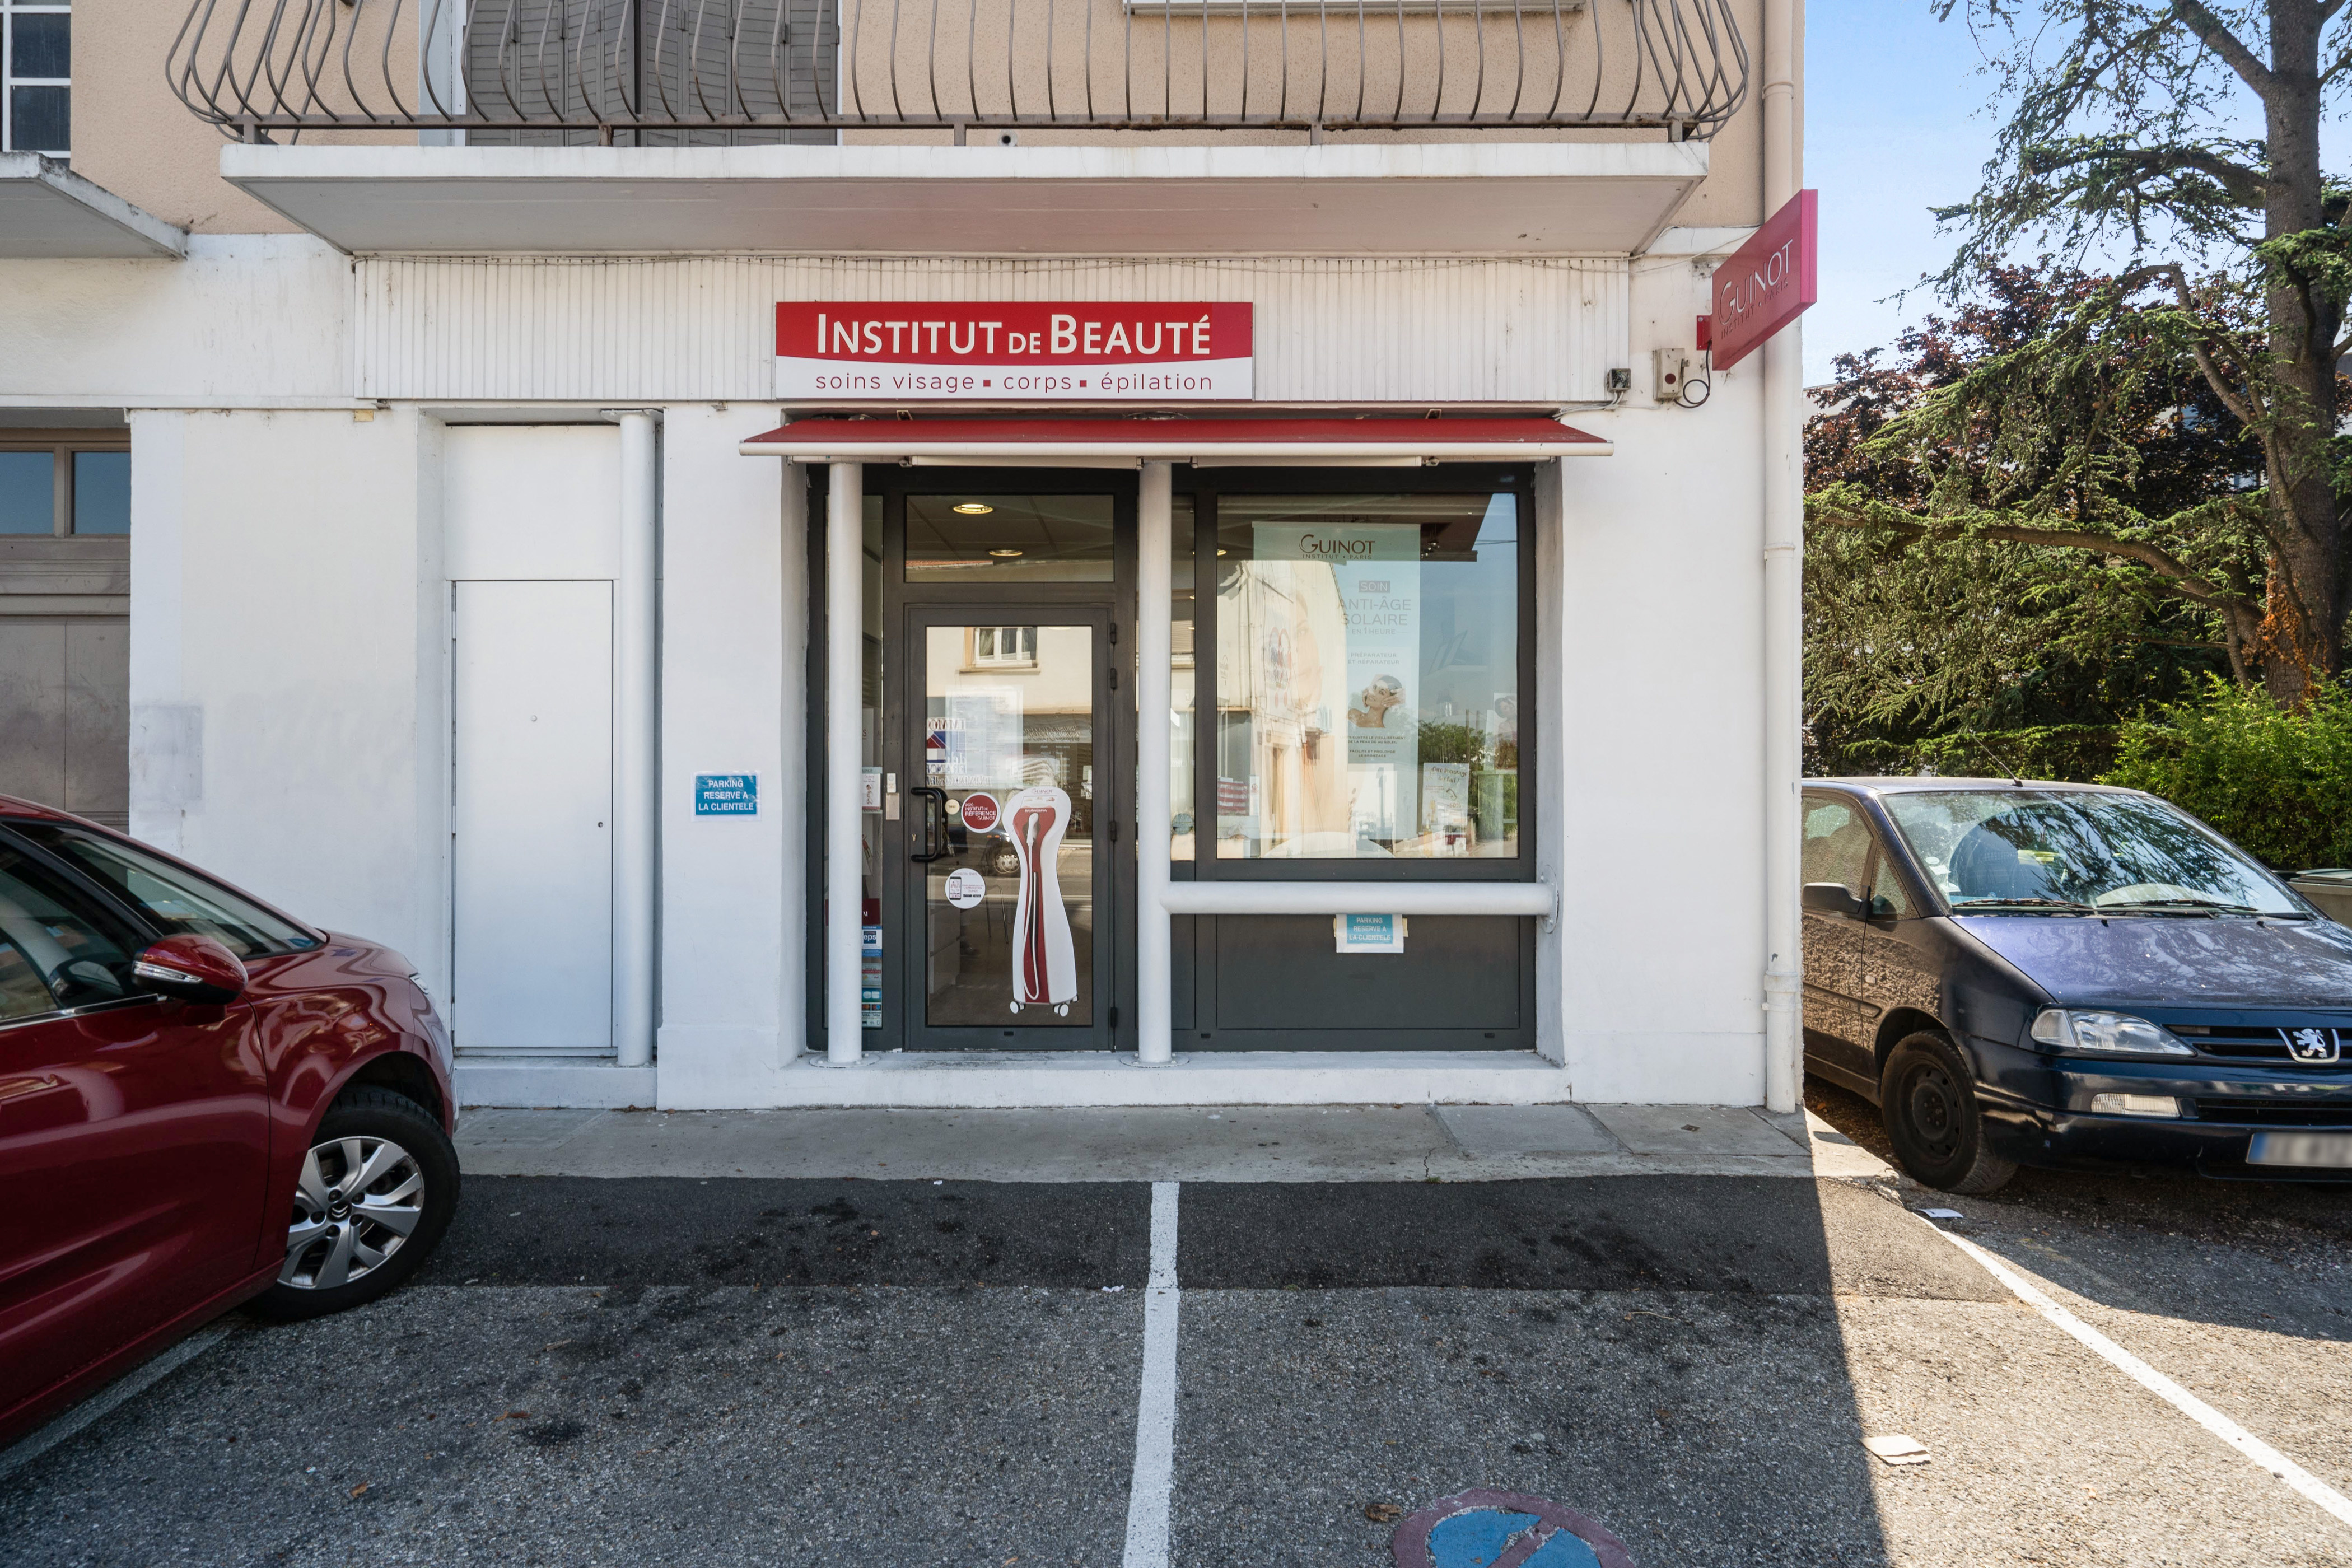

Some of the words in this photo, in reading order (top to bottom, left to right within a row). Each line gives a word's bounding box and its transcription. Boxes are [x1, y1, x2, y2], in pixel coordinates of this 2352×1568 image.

[1719, 239, 1793, 325] GUINOT
[1721, 304, 1754, 339] INSTITUT
[1765, 277, 1788, 304] PARIS
[817, 313, 1002, 354] INSTITUT
[1009, 332, 1042, 353] DE
[1051, 313, 1211, 355] BEAUTÉ
[816, 374, 881, 390] soins
[893, 374, 975, 393] visage
[1004, 374, 1072, 393] corps
[1101, 371, 1213, 393] épilation
[1299, 534, 1375, 554] GUINOT
[1361, 582, 1388, 591] SOIN
[1338, 596, 1411, 610] ANTI-ÂGE
[1342, 614, 1408, 626] SOLAIRE
[708, 780, 744, 788] PARKING
[698, 802, 708, 811] LA
[711, 802, 754, 811] CLIENTELE
